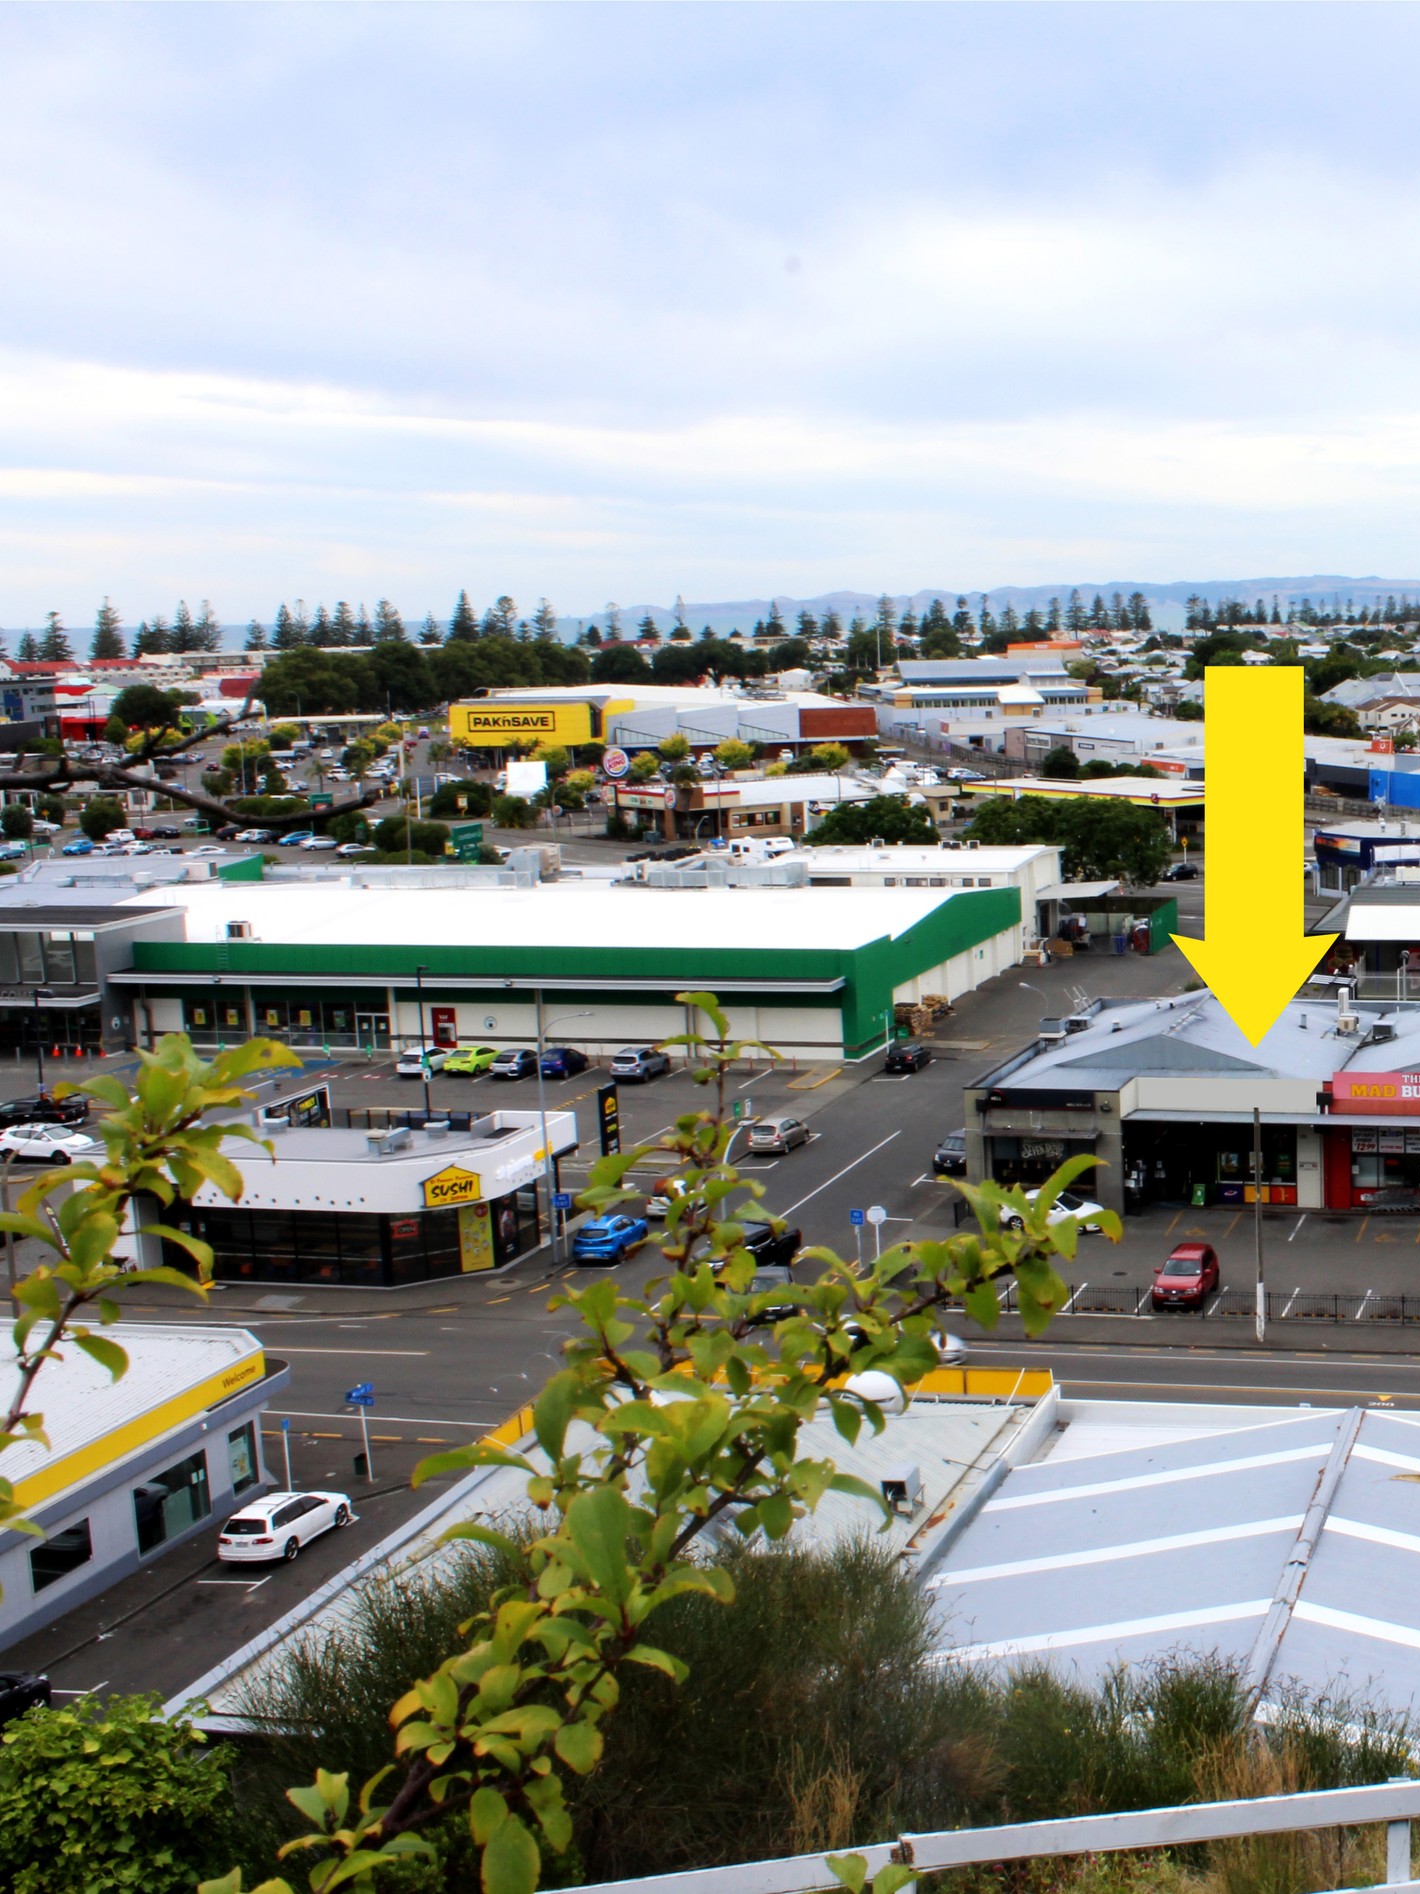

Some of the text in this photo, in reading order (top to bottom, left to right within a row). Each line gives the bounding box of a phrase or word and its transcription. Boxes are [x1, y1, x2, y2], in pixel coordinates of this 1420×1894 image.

[1351, 1084, 1396, 1098] MAD
[431, 1179, 473, 1198] SUSHI
[222, 1365, 256, 1389] Welcome
